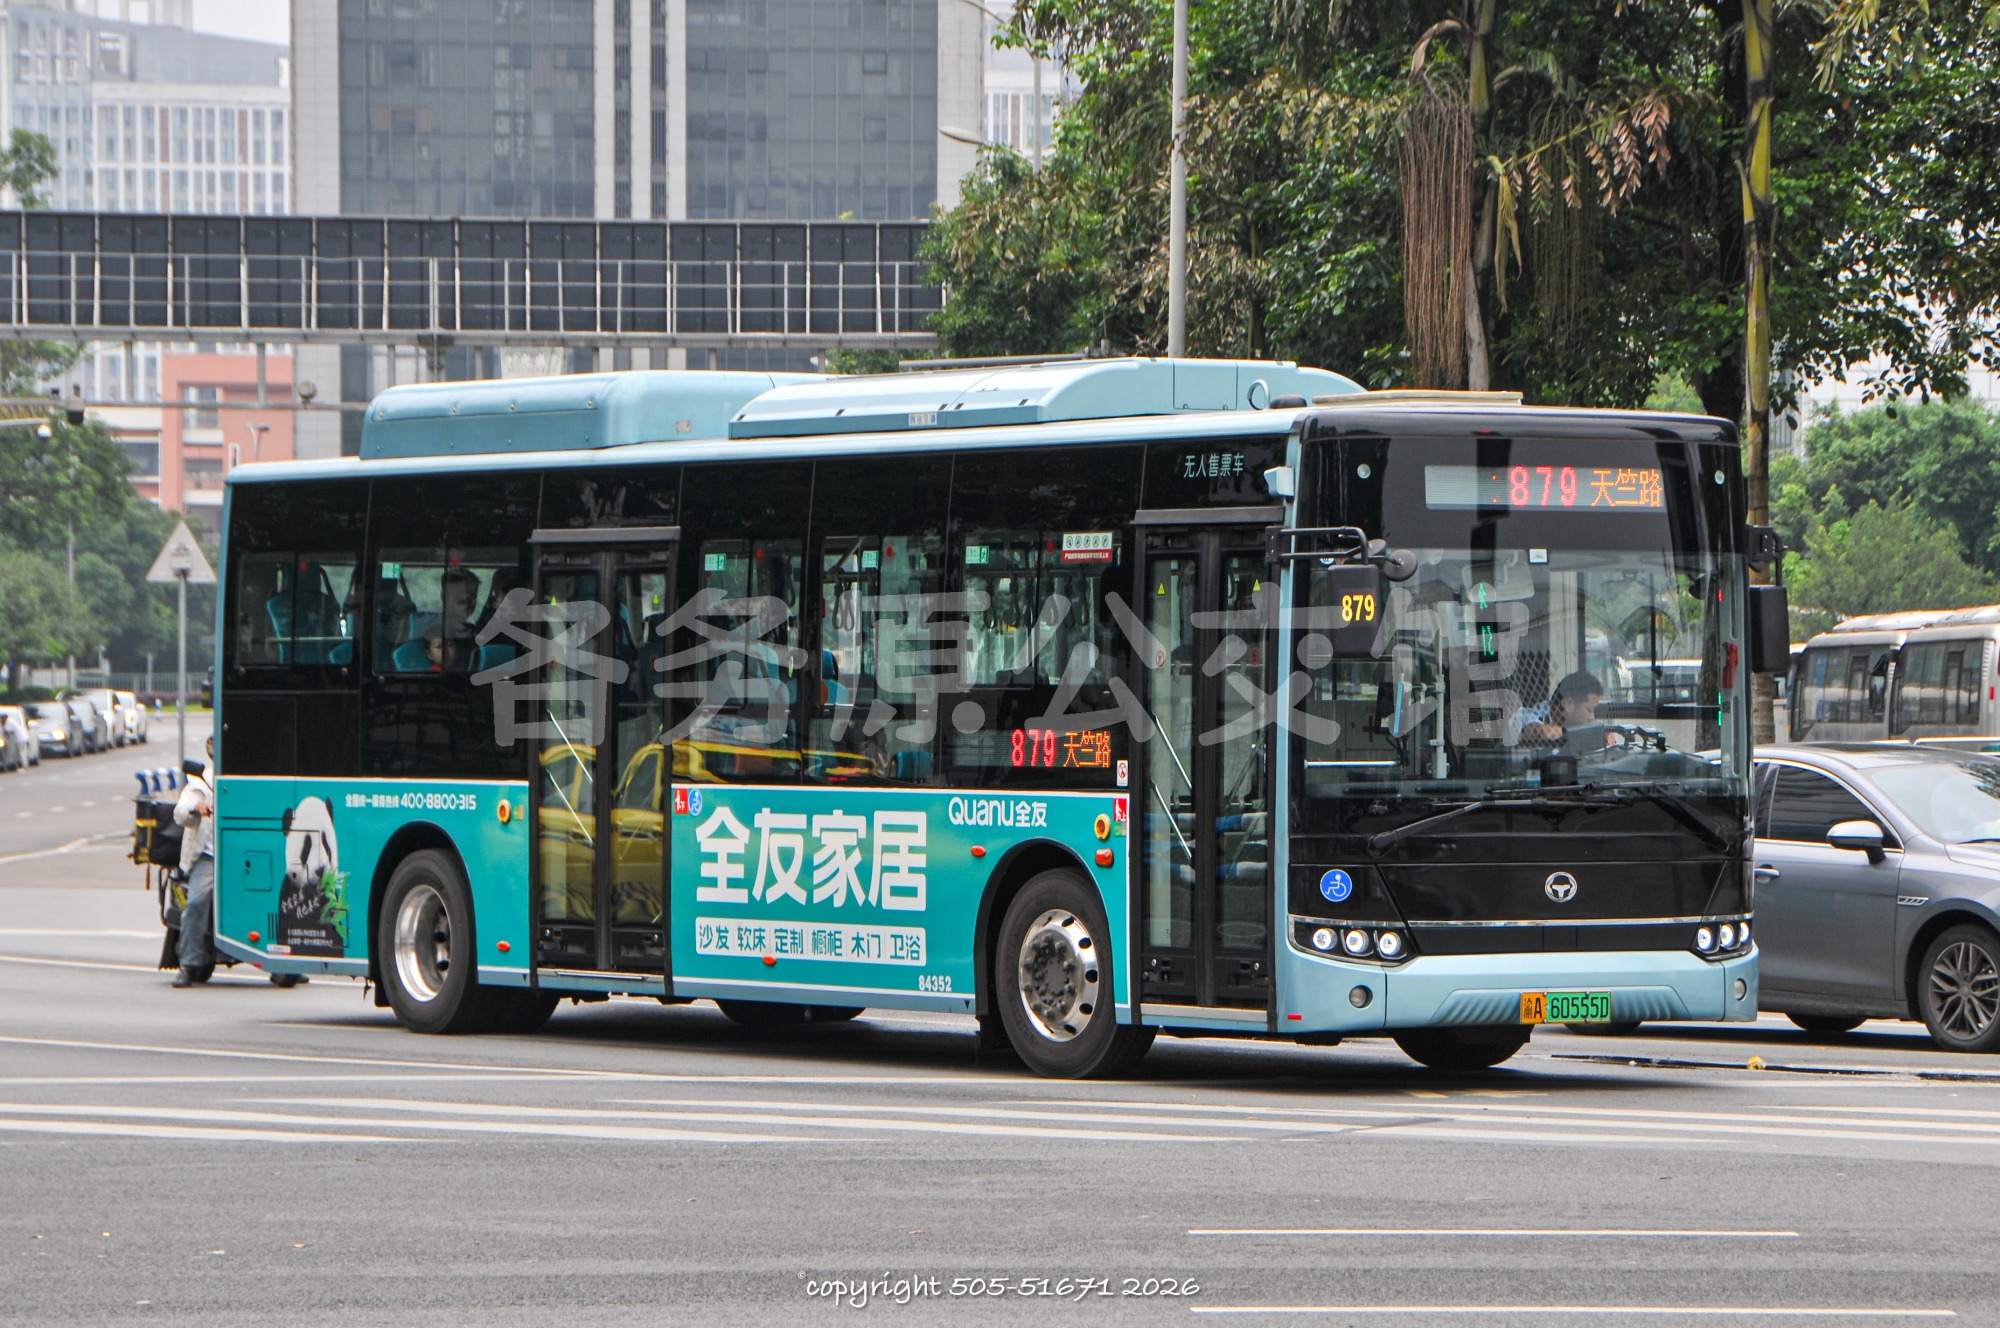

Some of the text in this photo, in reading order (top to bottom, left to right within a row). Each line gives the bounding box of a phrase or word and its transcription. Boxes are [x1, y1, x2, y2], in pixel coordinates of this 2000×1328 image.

[1183, 452, 1244, 478] 无人售票车
[1510, 465, 1663, 507] 879 天竺路
[1341, 594, 1376, 622] 879
[1011, 729, 1111, 768] 879 天竺路
[695, 806, 927, 911] 全友家居
[698, 924, 921, 961] 沙发 软床 定制 橱柜 木门 卫浴
[918, 974, 952, 993] 84352
